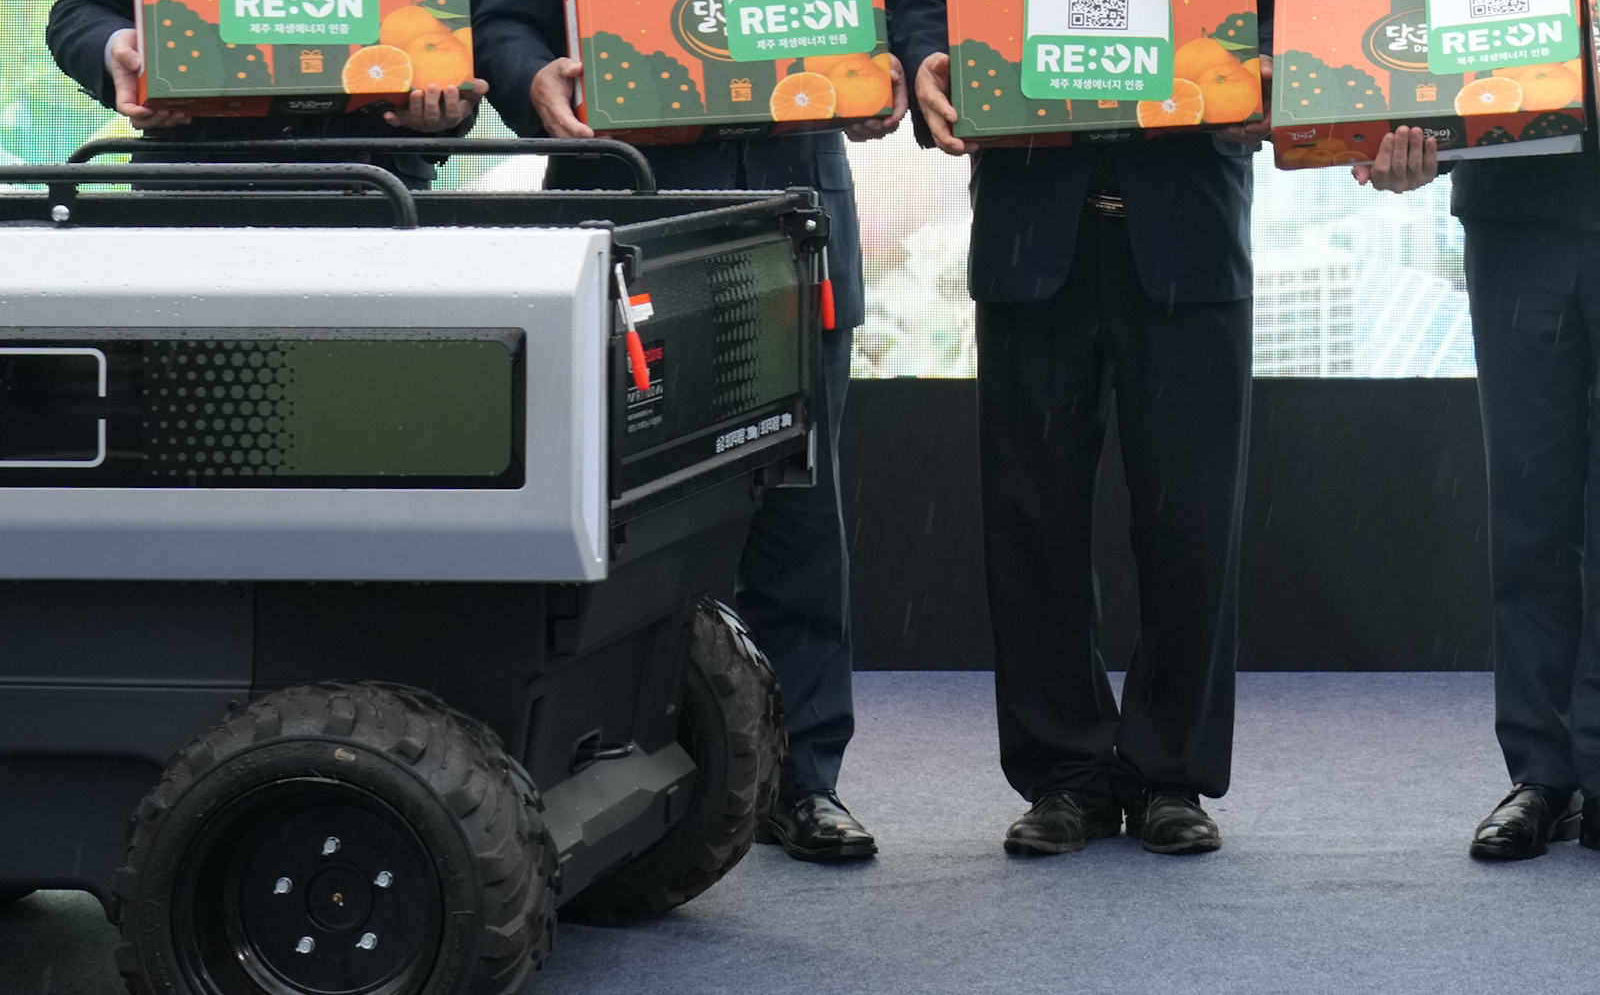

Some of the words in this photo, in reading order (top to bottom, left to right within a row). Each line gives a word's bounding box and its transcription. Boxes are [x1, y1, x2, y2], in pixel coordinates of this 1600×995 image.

[739, 0, 859, 36] RE:ON
[250, 23, 272, 34] 제주
[274, 22, 326, 35] 재생에너지
[328, 23, 350, 35] 인증
[1441, 20, 1563, 54] RE:ON
[756, 38, 777, 50] 제주
[778, 35, 827, 49] 재생에너지
[828, 33, 848, 46] 인증
[1037, 44, 1158, 74] RE:ON
[1456, 55, 1477, 65] 제주
[1478, 49, 1529, 63] 재생에너지
[1530, 47, 1551, 58] 인증
[1050, 77, 1070, 89] 제주
[1072, 78, 1122, 90] 재생에너지
[1124, 79, 1145, 91] 인증
